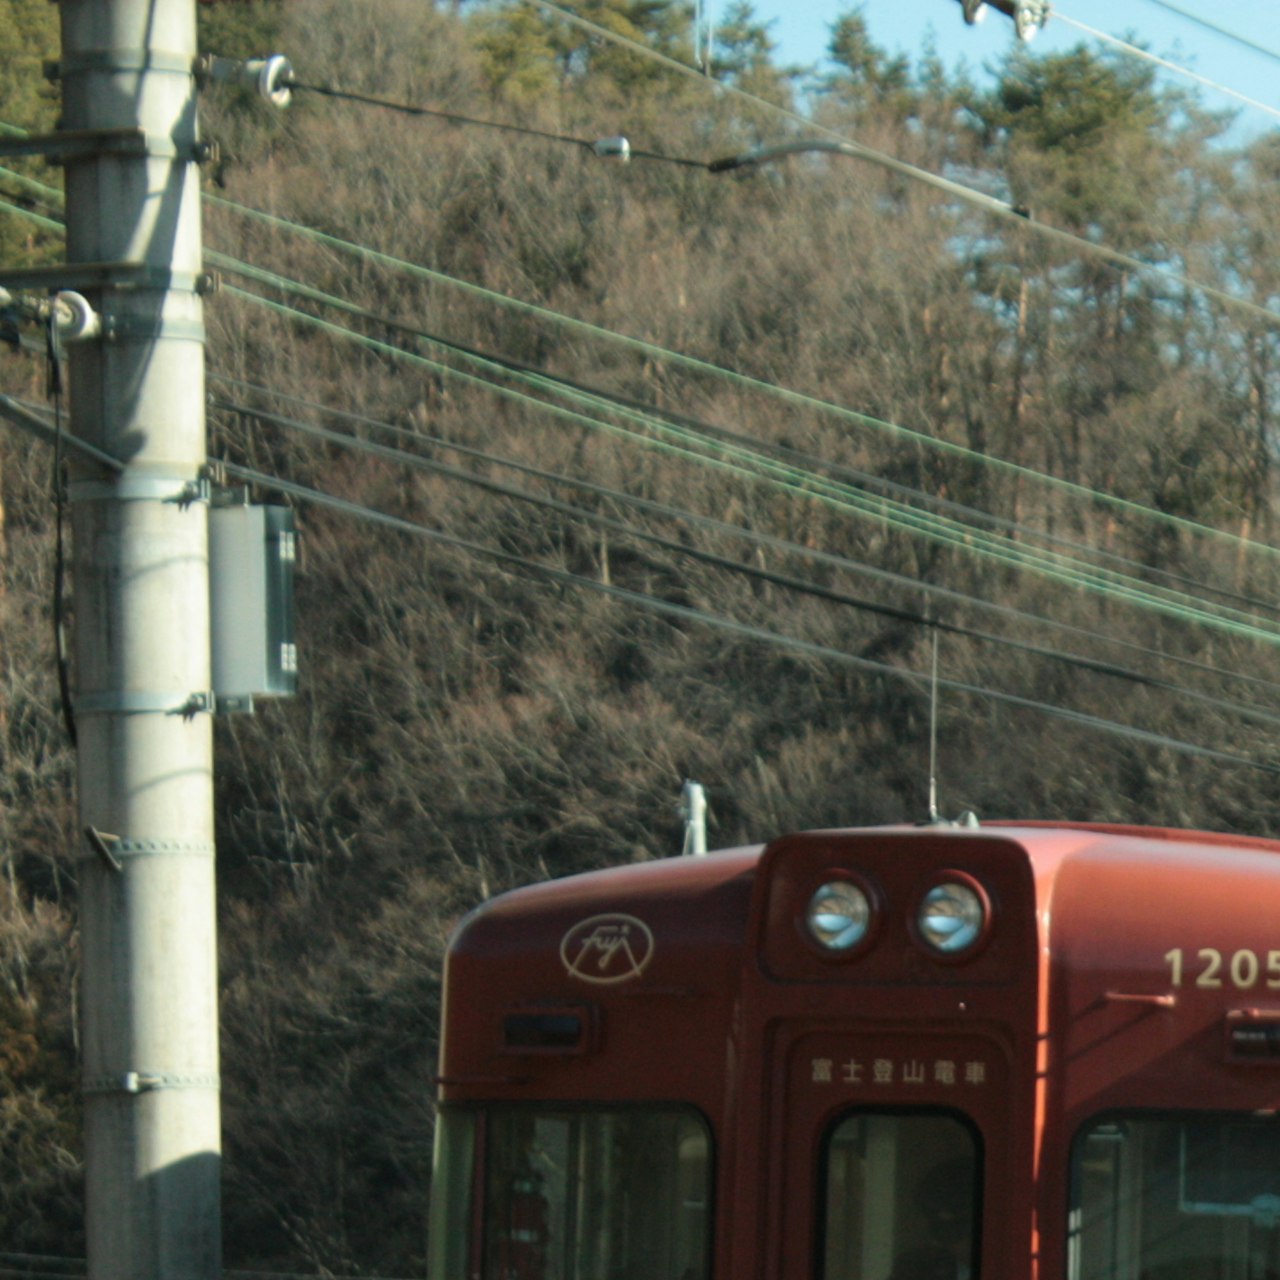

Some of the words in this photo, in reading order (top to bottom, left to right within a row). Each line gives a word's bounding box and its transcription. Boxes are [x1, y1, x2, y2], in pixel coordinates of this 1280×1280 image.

[811, 1057, 986, 1085] 富士登山電車
